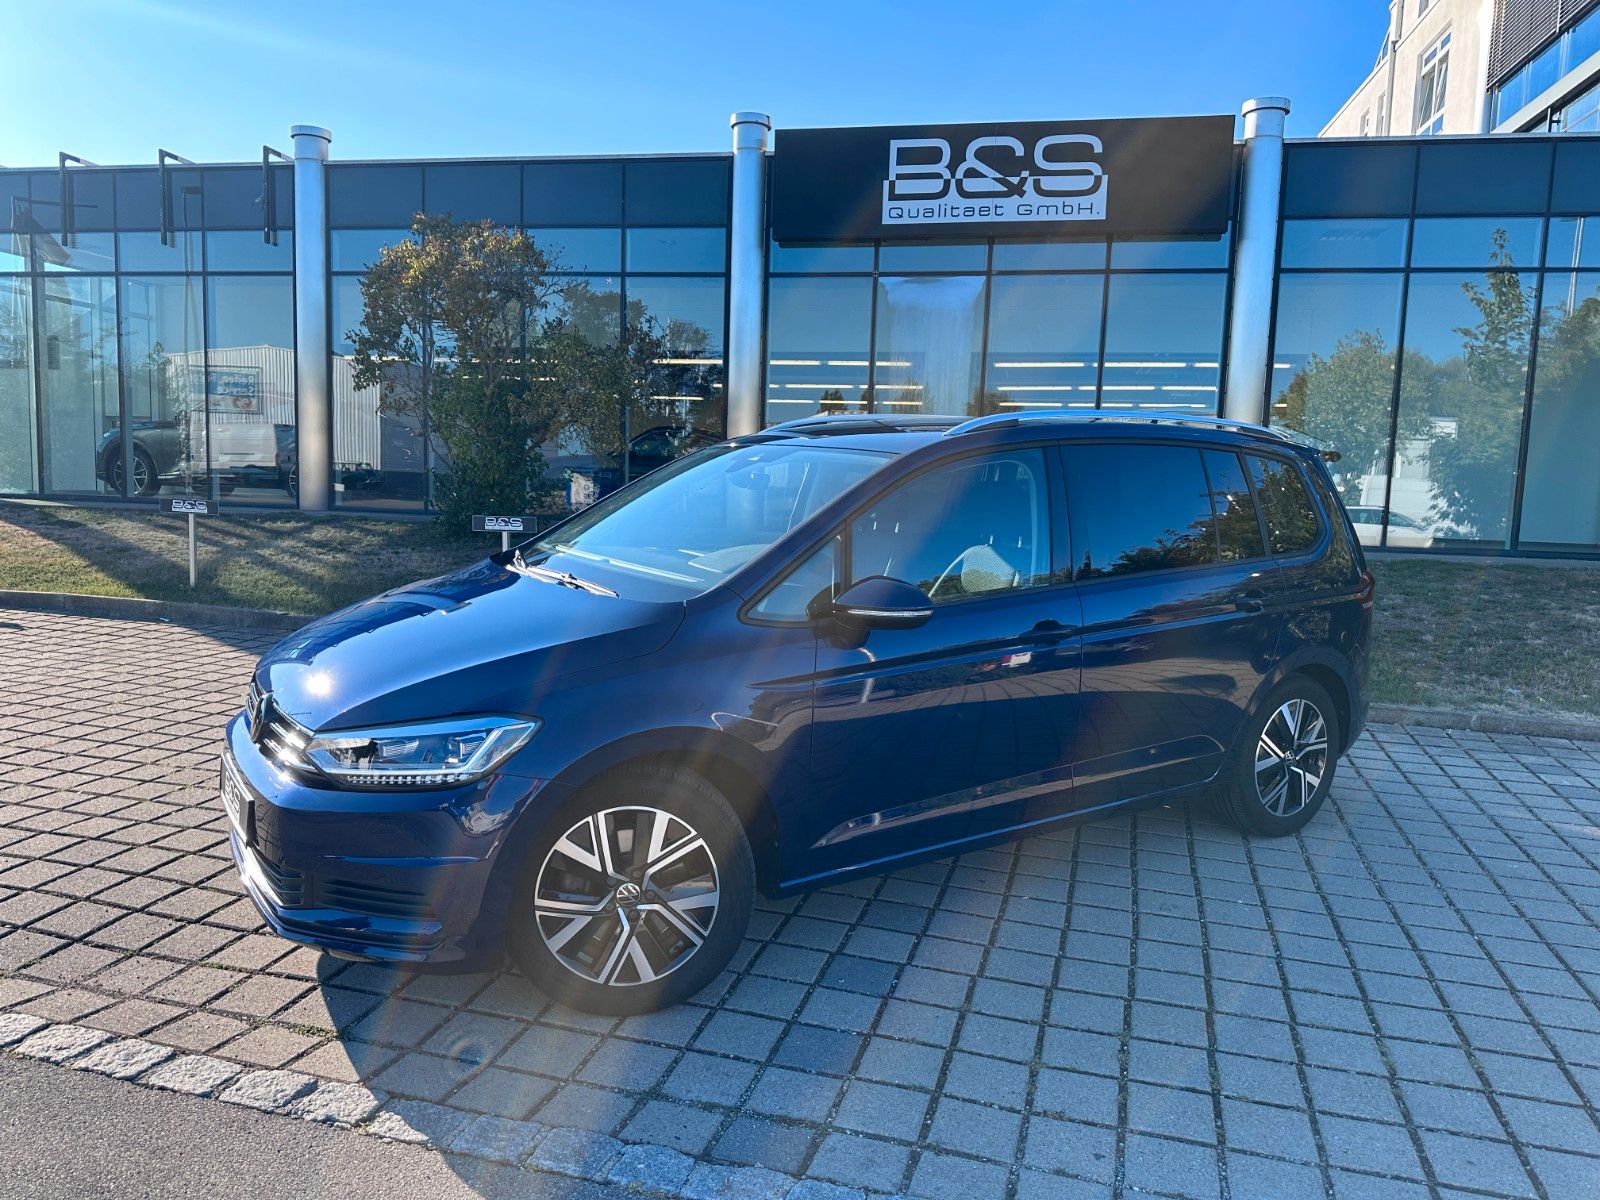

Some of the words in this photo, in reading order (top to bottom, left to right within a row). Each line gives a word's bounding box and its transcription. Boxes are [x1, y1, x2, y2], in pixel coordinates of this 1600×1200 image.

[888, 134, 1103, 201] B&S
[888, 203, 1004, 219] Qualitaet
[1016, 201, 1101, 216] GmbH.
[172, 499, 207, 511] B&S
[485, 517, 522, 527] B&S
